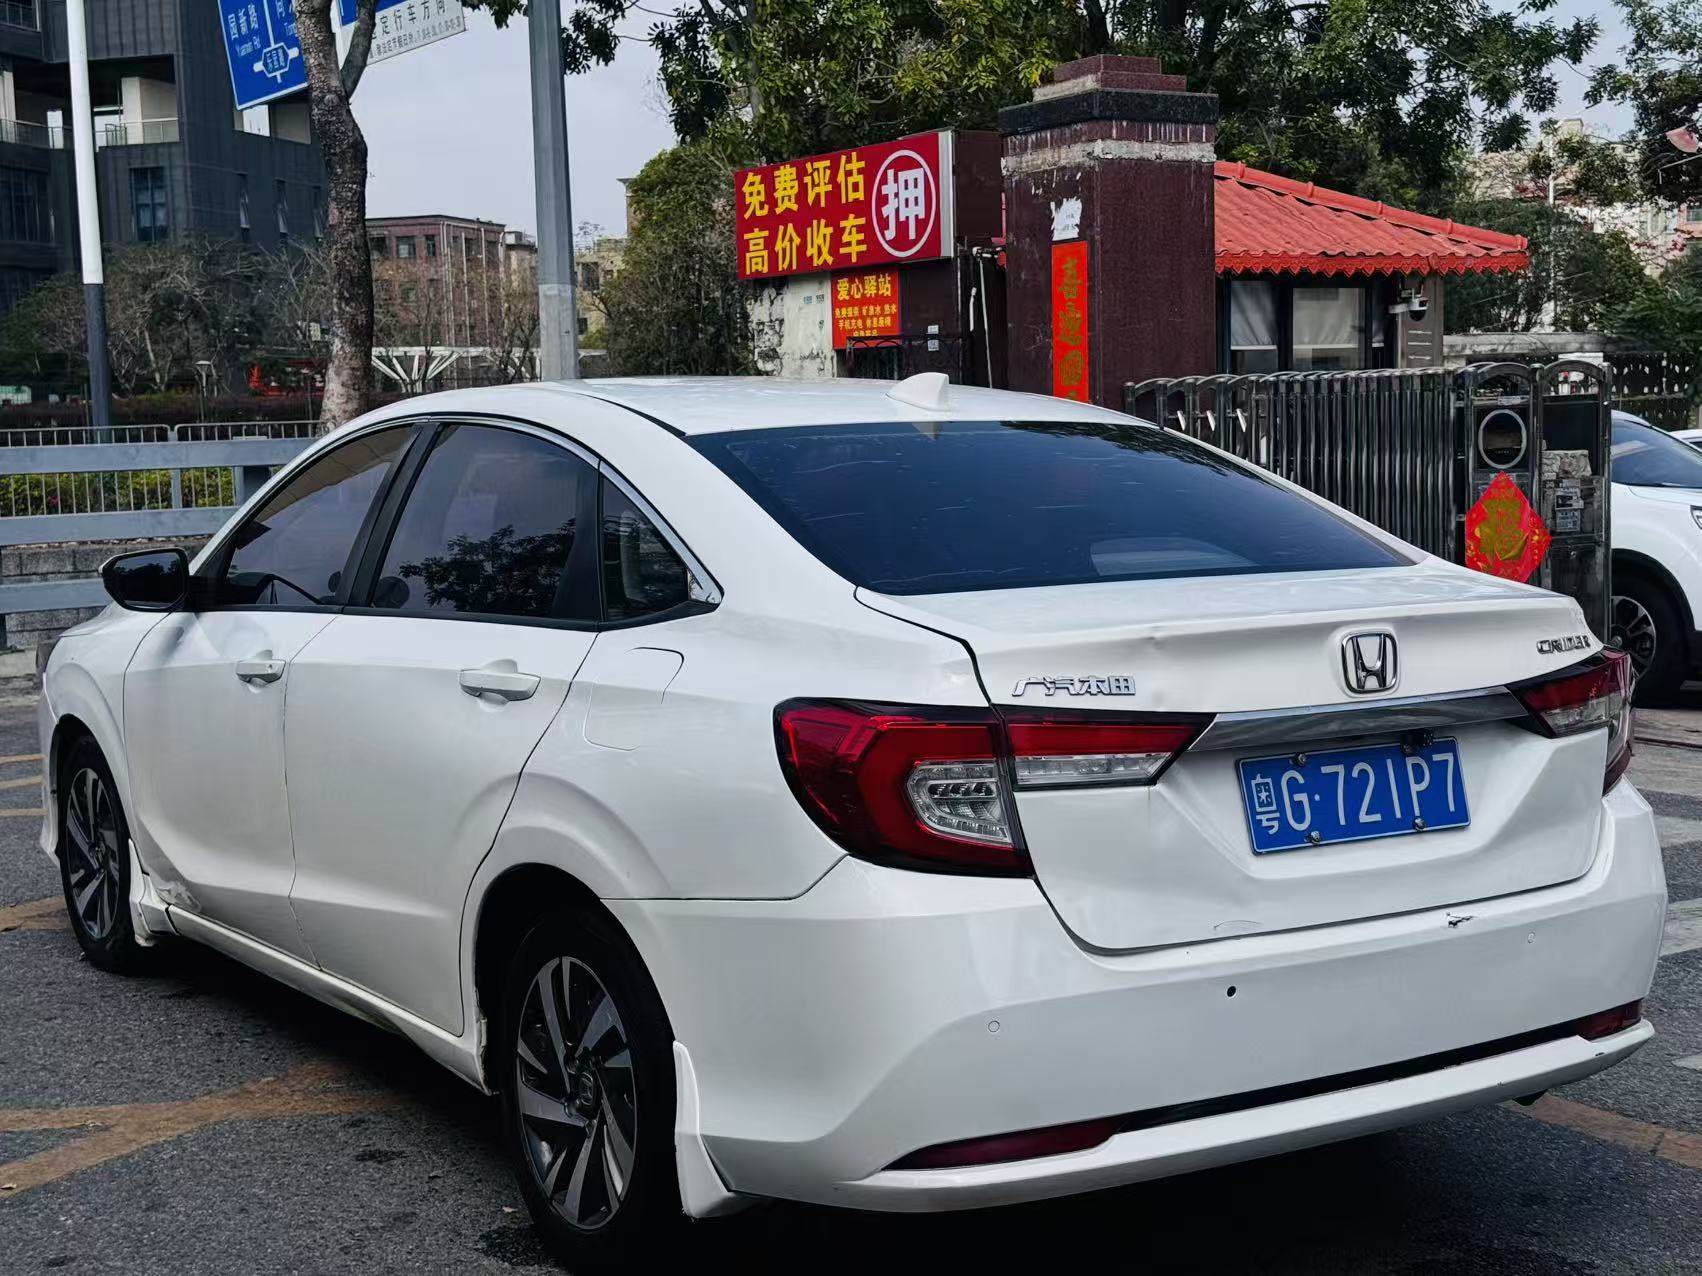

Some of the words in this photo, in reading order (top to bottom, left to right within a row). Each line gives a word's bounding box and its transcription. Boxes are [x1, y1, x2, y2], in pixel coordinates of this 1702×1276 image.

[741, 151, 866, 220] 免费评估
[881, 167, 927, 242] 押
[743, 213, 868, 275] 高价收车
[836, 273, 892, 300] 爱心驿站
[838, 319, 863, 330] 手机充电
[1536, 635, 1591, 654] CRIDER
[1012, 675, 1136, 697] 广汽本田
